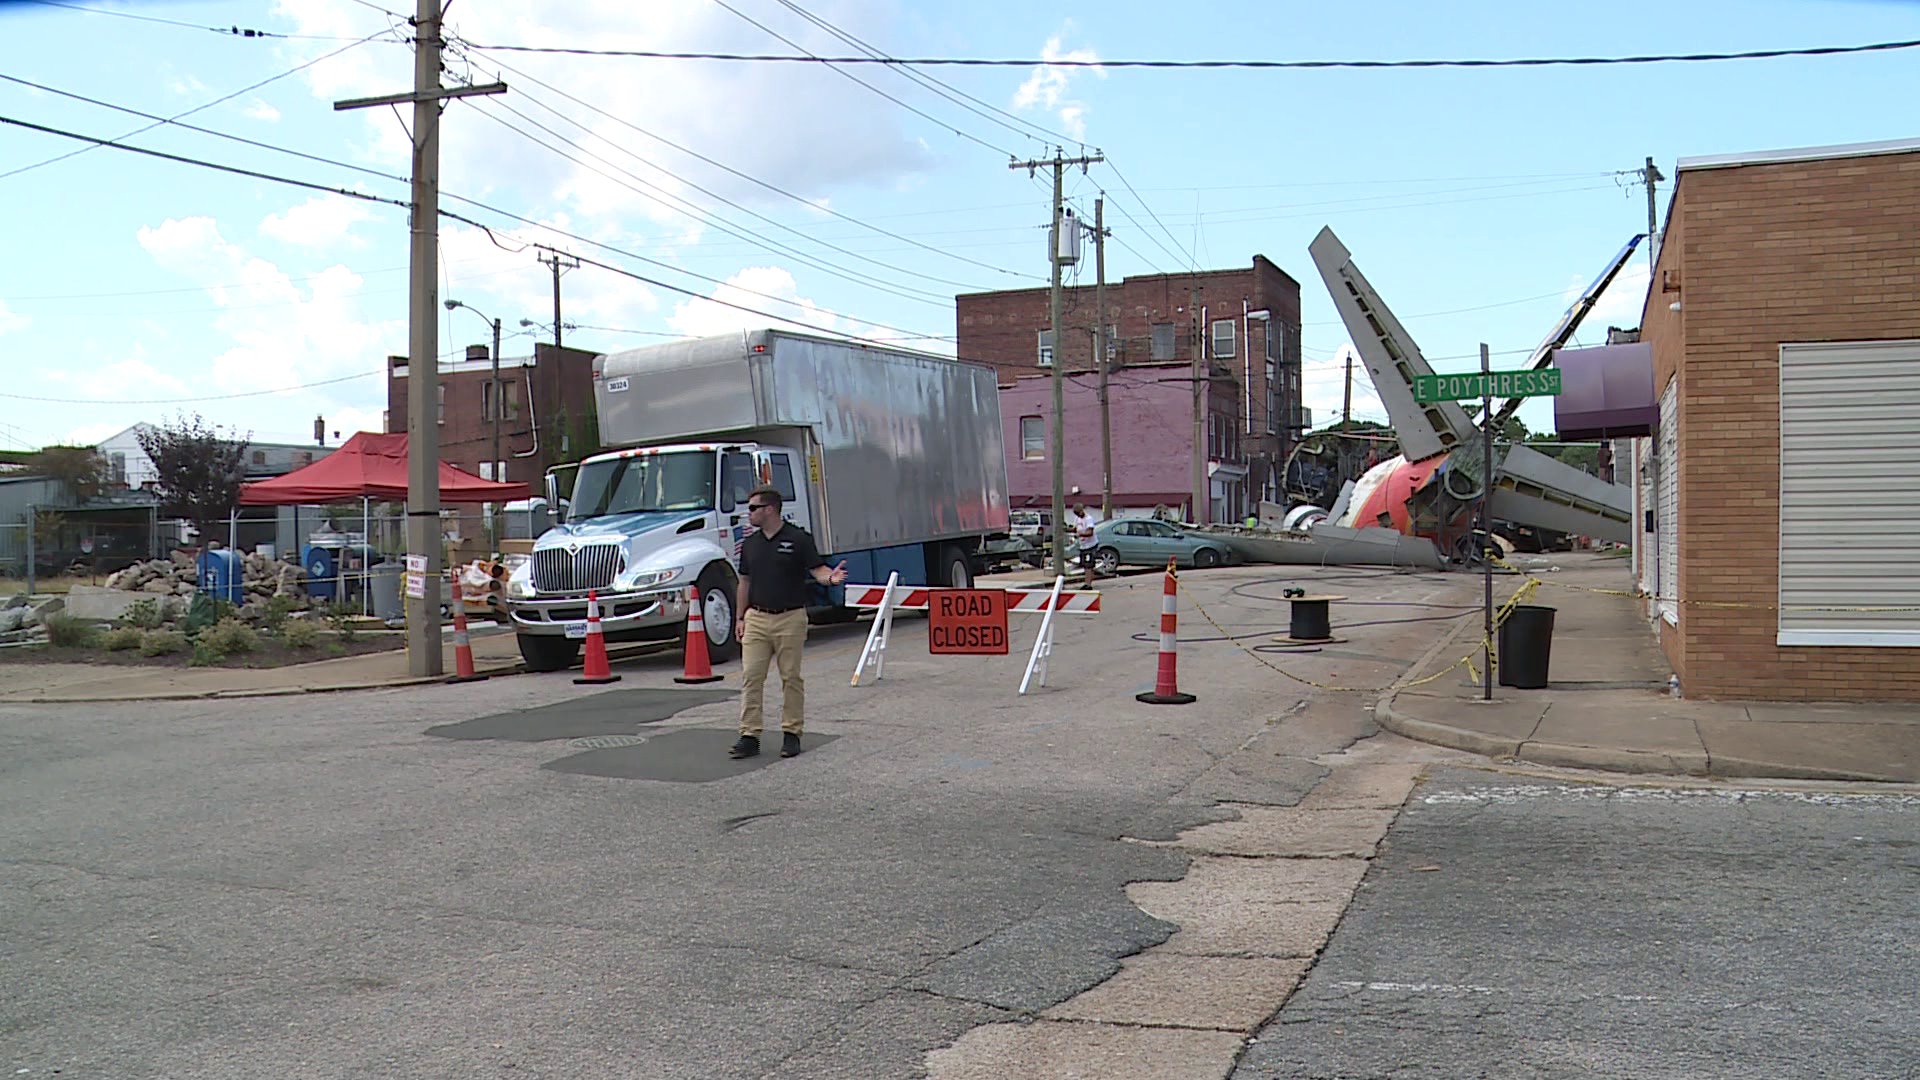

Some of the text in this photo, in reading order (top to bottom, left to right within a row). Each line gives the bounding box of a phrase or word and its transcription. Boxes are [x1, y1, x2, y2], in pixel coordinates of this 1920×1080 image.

[1417, 373, 1559, 399] E POYTHRESS ST
[941, 595, 992, 617] ROAD
[933, 626, 1004, 648] CLOSED
